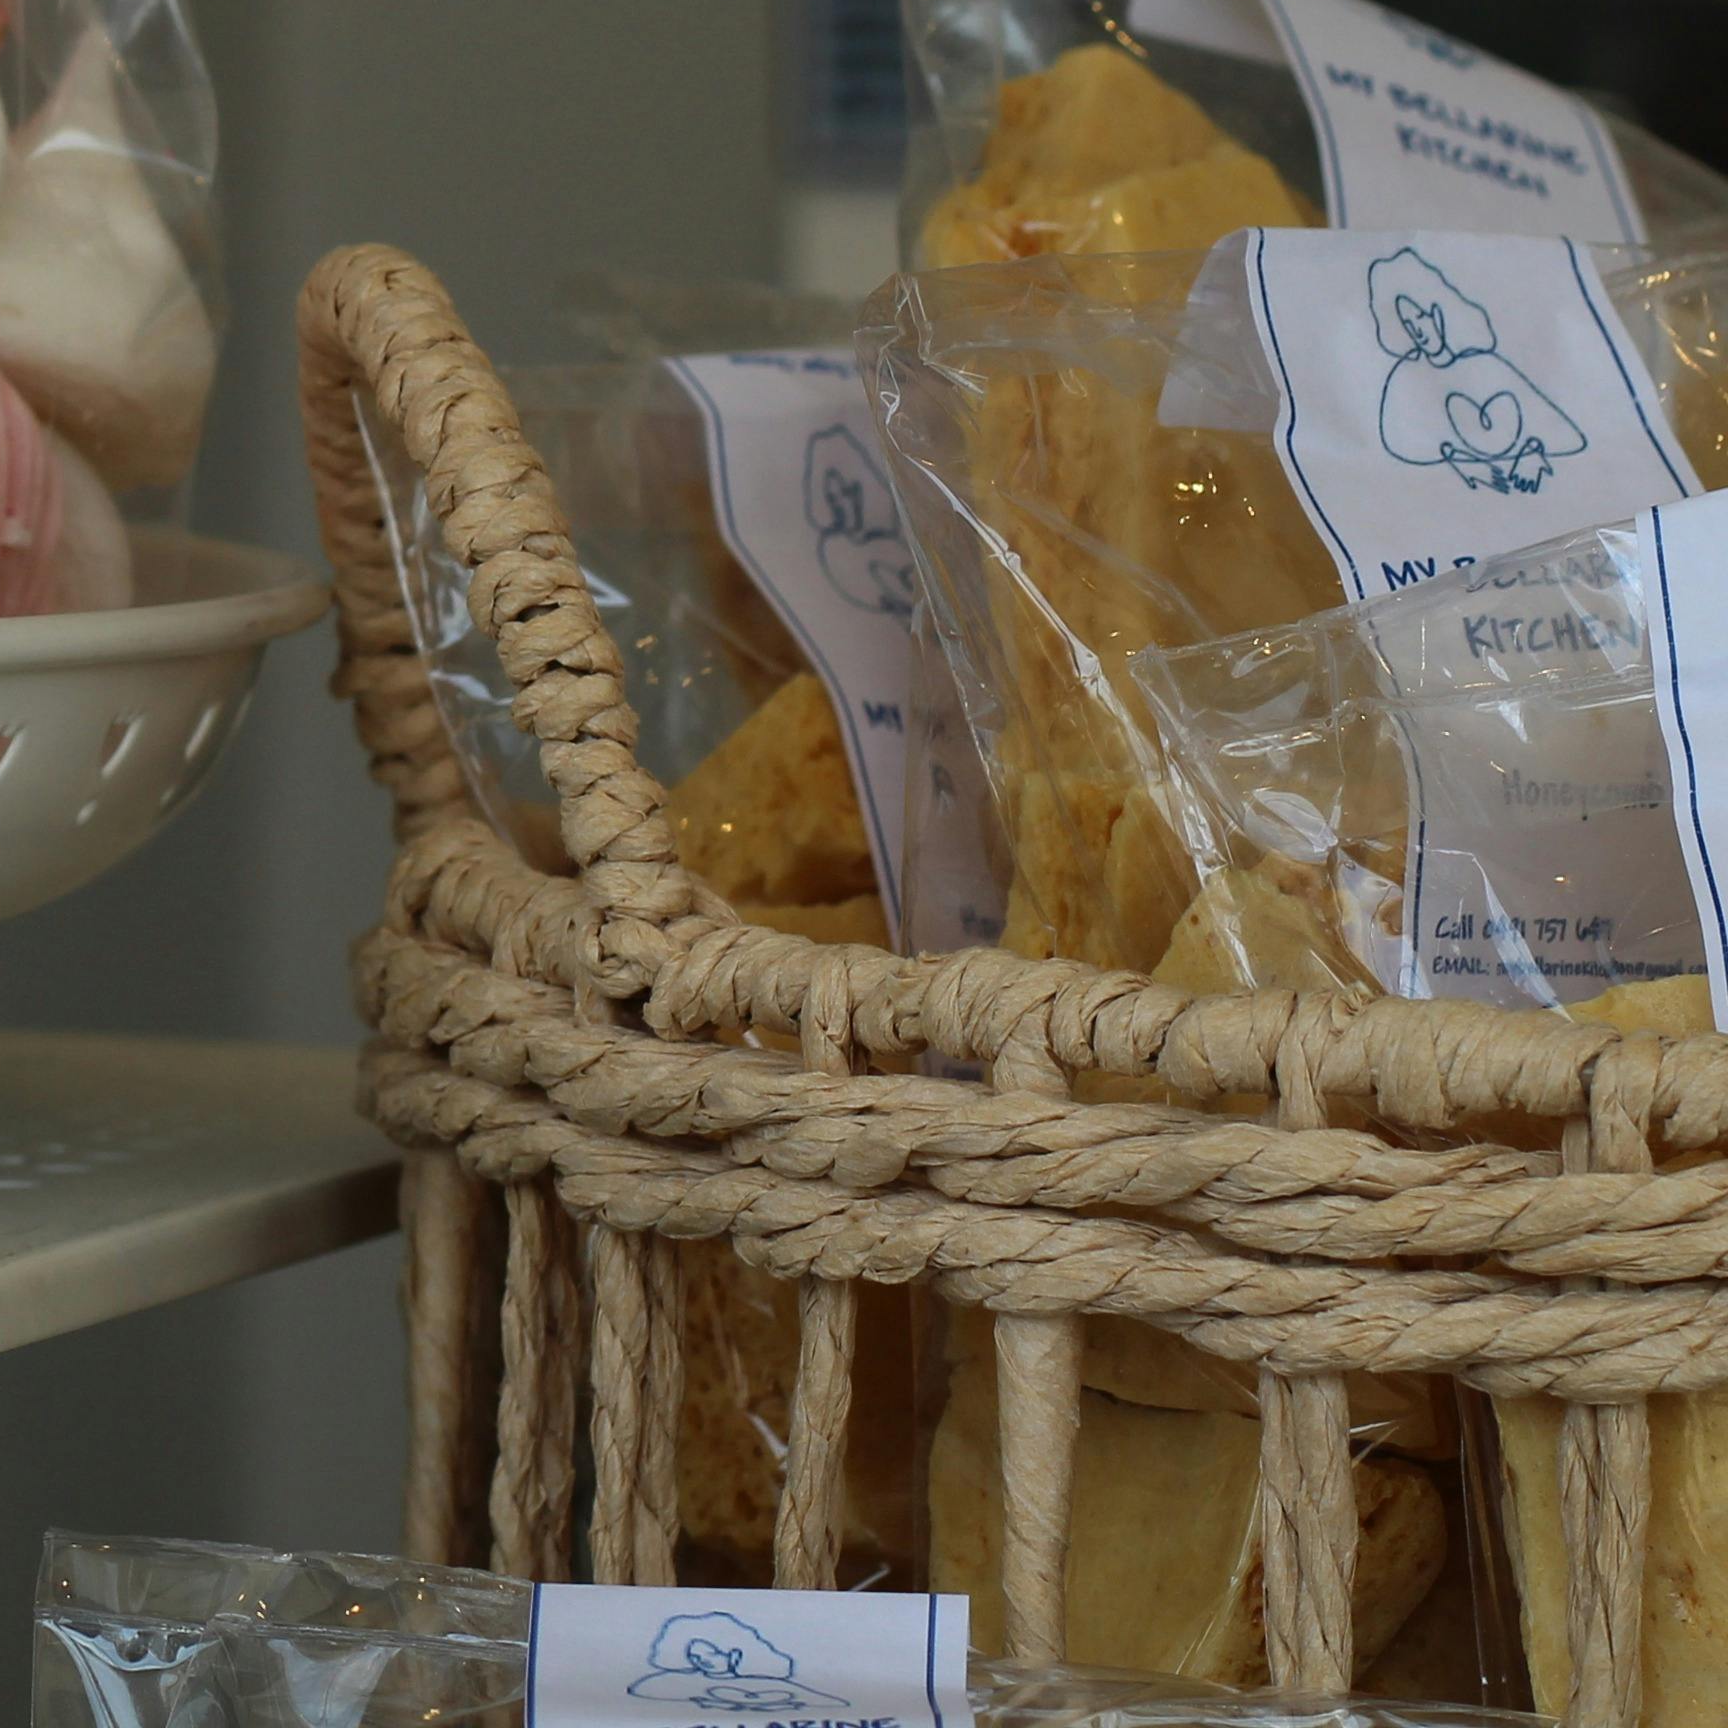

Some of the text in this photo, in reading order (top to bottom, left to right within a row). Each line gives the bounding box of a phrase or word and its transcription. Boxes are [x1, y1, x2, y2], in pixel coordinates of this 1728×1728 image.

[1462, 614, 1639, 659] KITCHEN
[1434, 914, 1474, 941] Call
[1532, 917, 1567, 943] 757
[1432, 955, 1490, 976] EMAIL:
